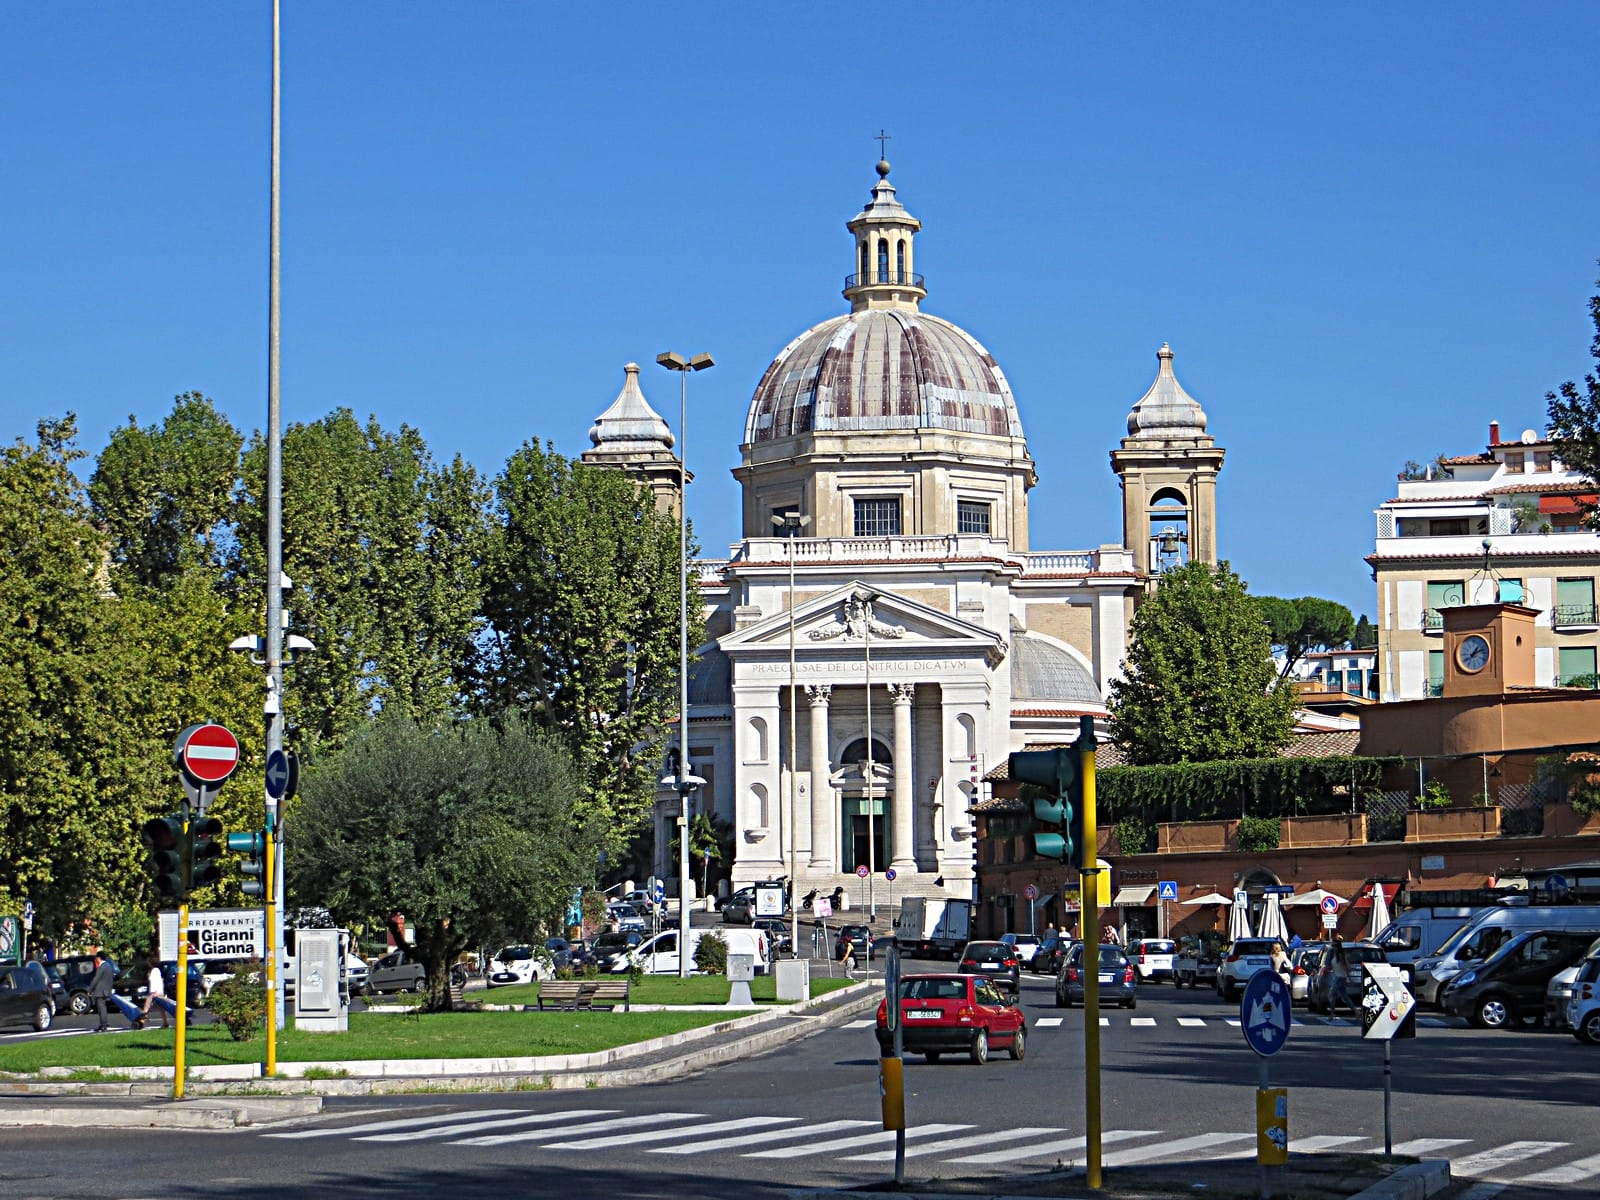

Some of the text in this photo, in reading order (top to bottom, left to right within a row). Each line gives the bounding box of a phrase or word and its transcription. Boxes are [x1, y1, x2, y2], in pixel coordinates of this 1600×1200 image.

[752, 663, 823, 673] PRAECLSAE
[827, 663, 846, 672] DEI
[913, 660, 967, 670] DICATVM
[188, 918, 255, 926] RREDAMENTI
[201, 928, 254, 941] Gianni
[201, 942, 254, 954] Gianna
